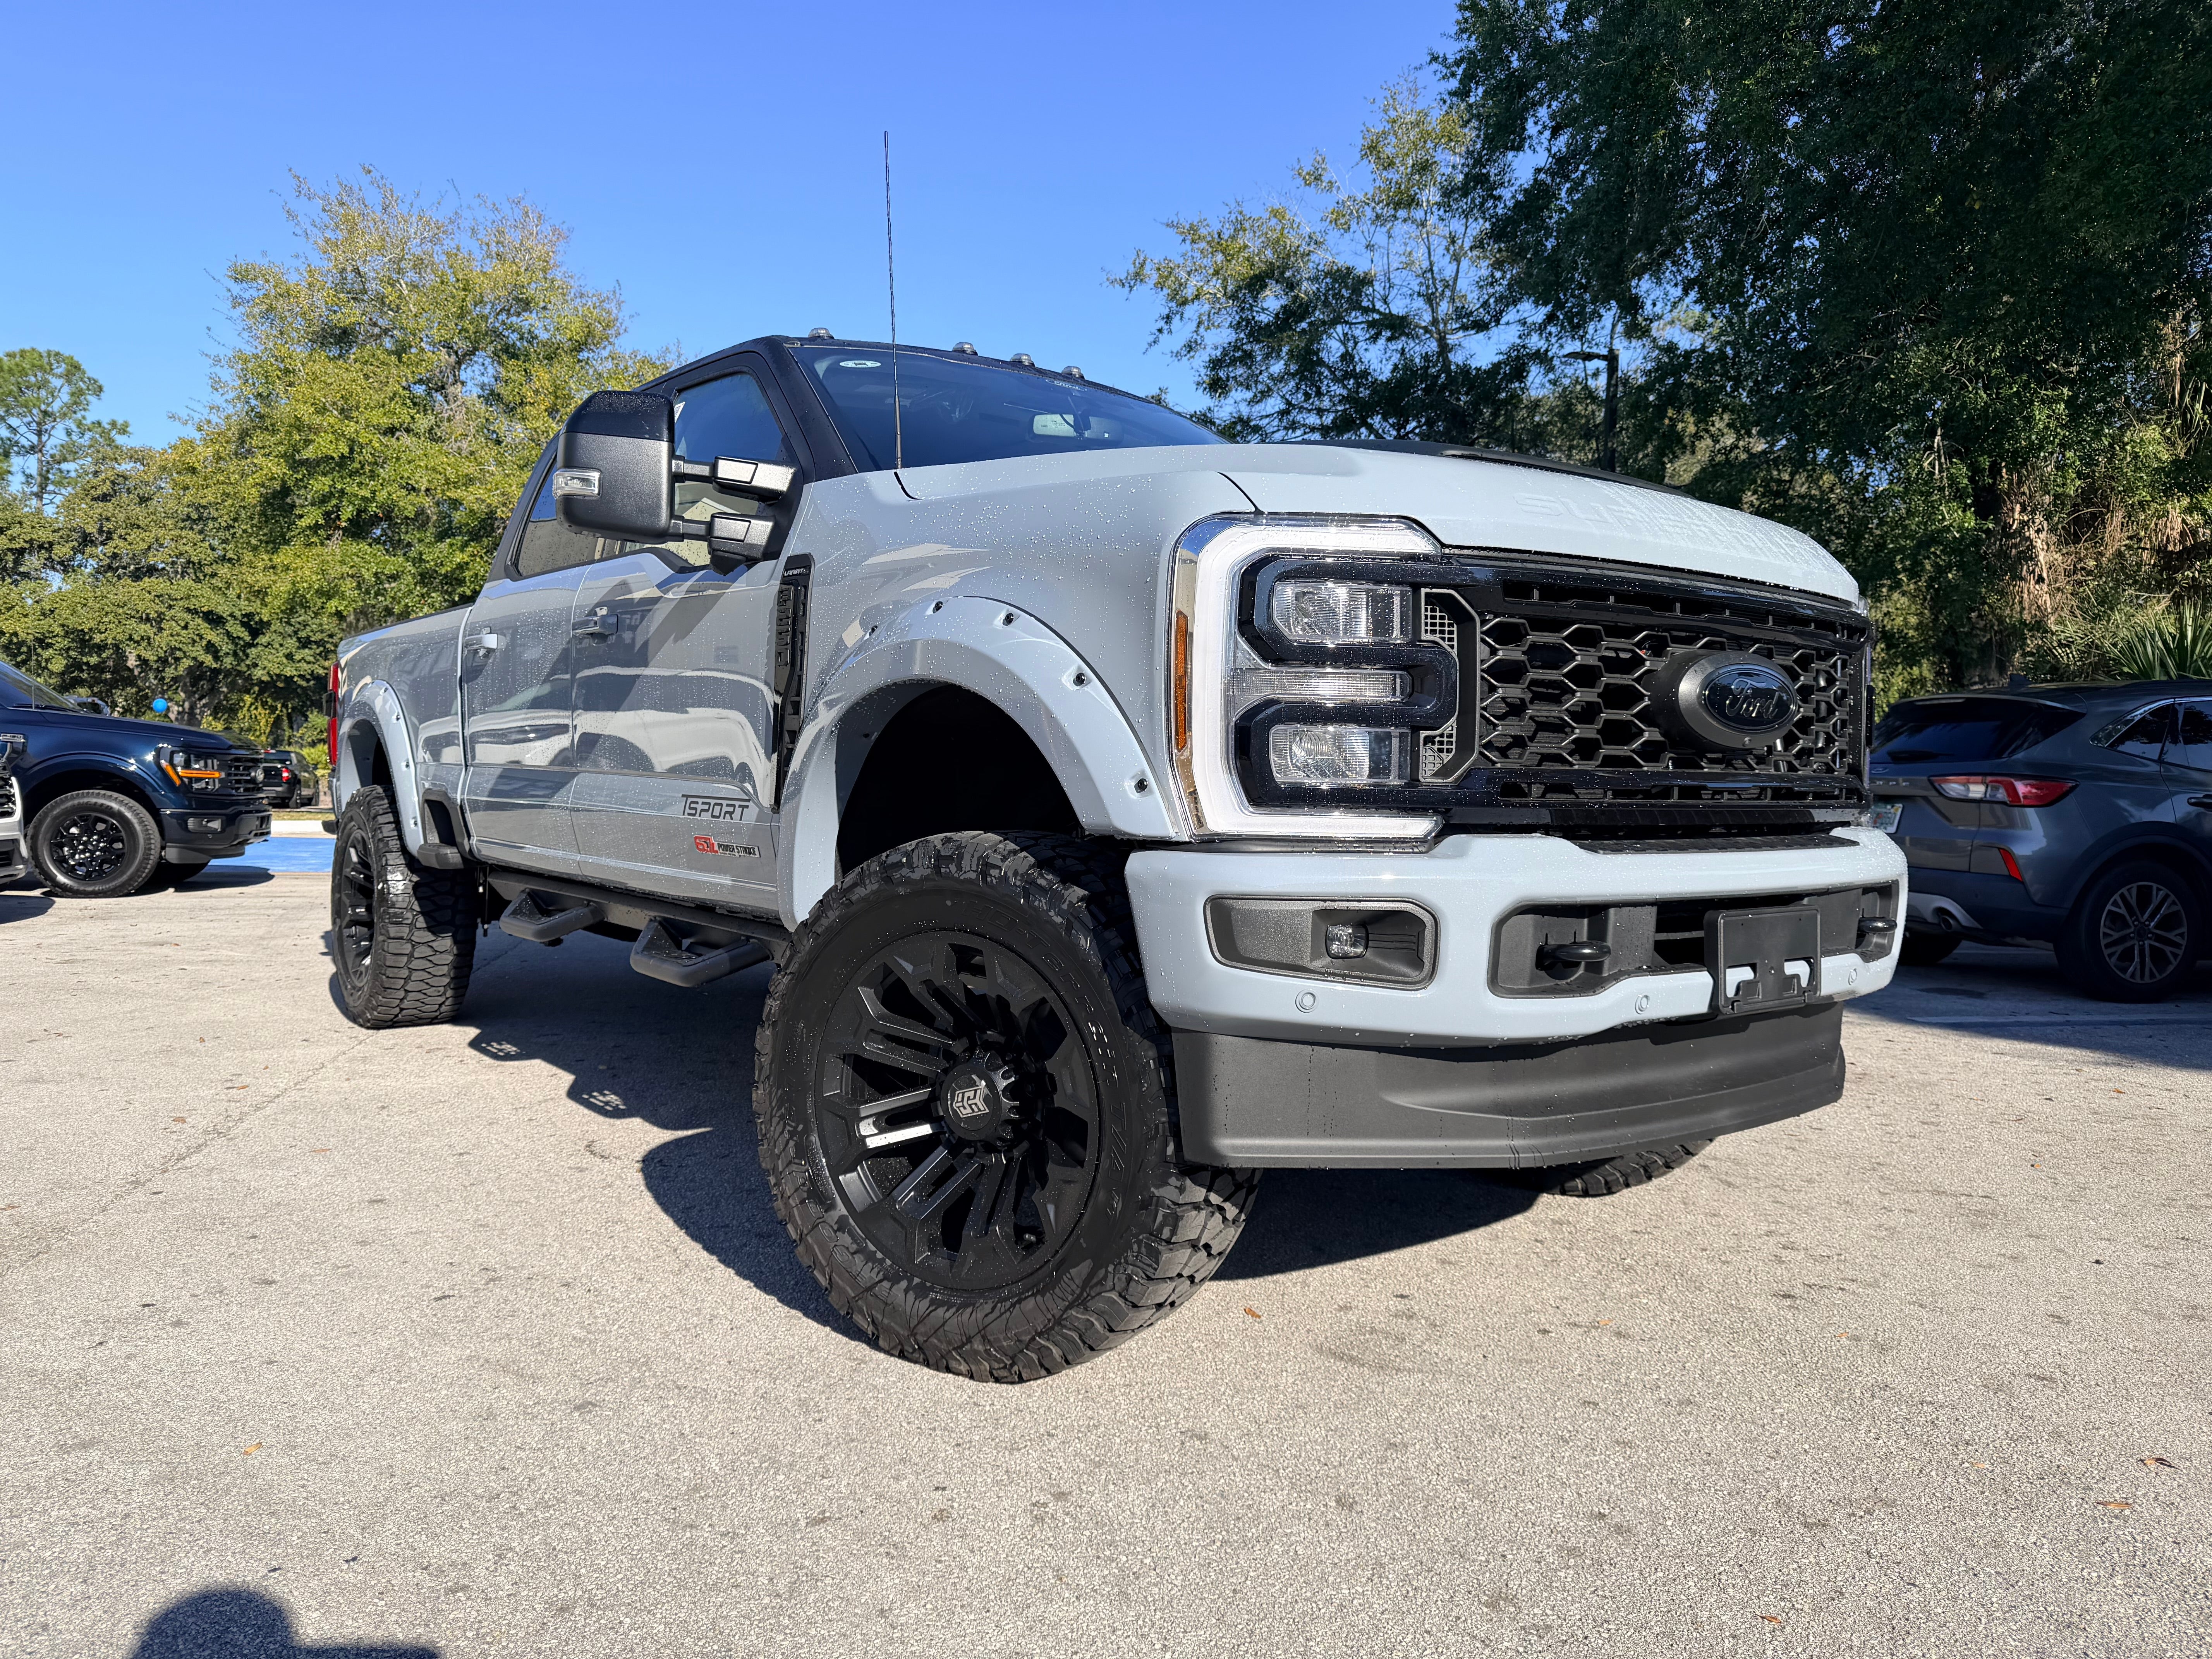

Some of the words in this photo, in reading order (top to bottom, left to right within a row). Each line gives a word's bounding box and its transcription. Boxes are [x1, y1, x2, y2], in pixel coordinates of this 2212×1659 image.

[1726, 678, 1779, 719] Ford
[716, 842, 735, 853] POWER
[735, 845, 757, 856] STROKE
